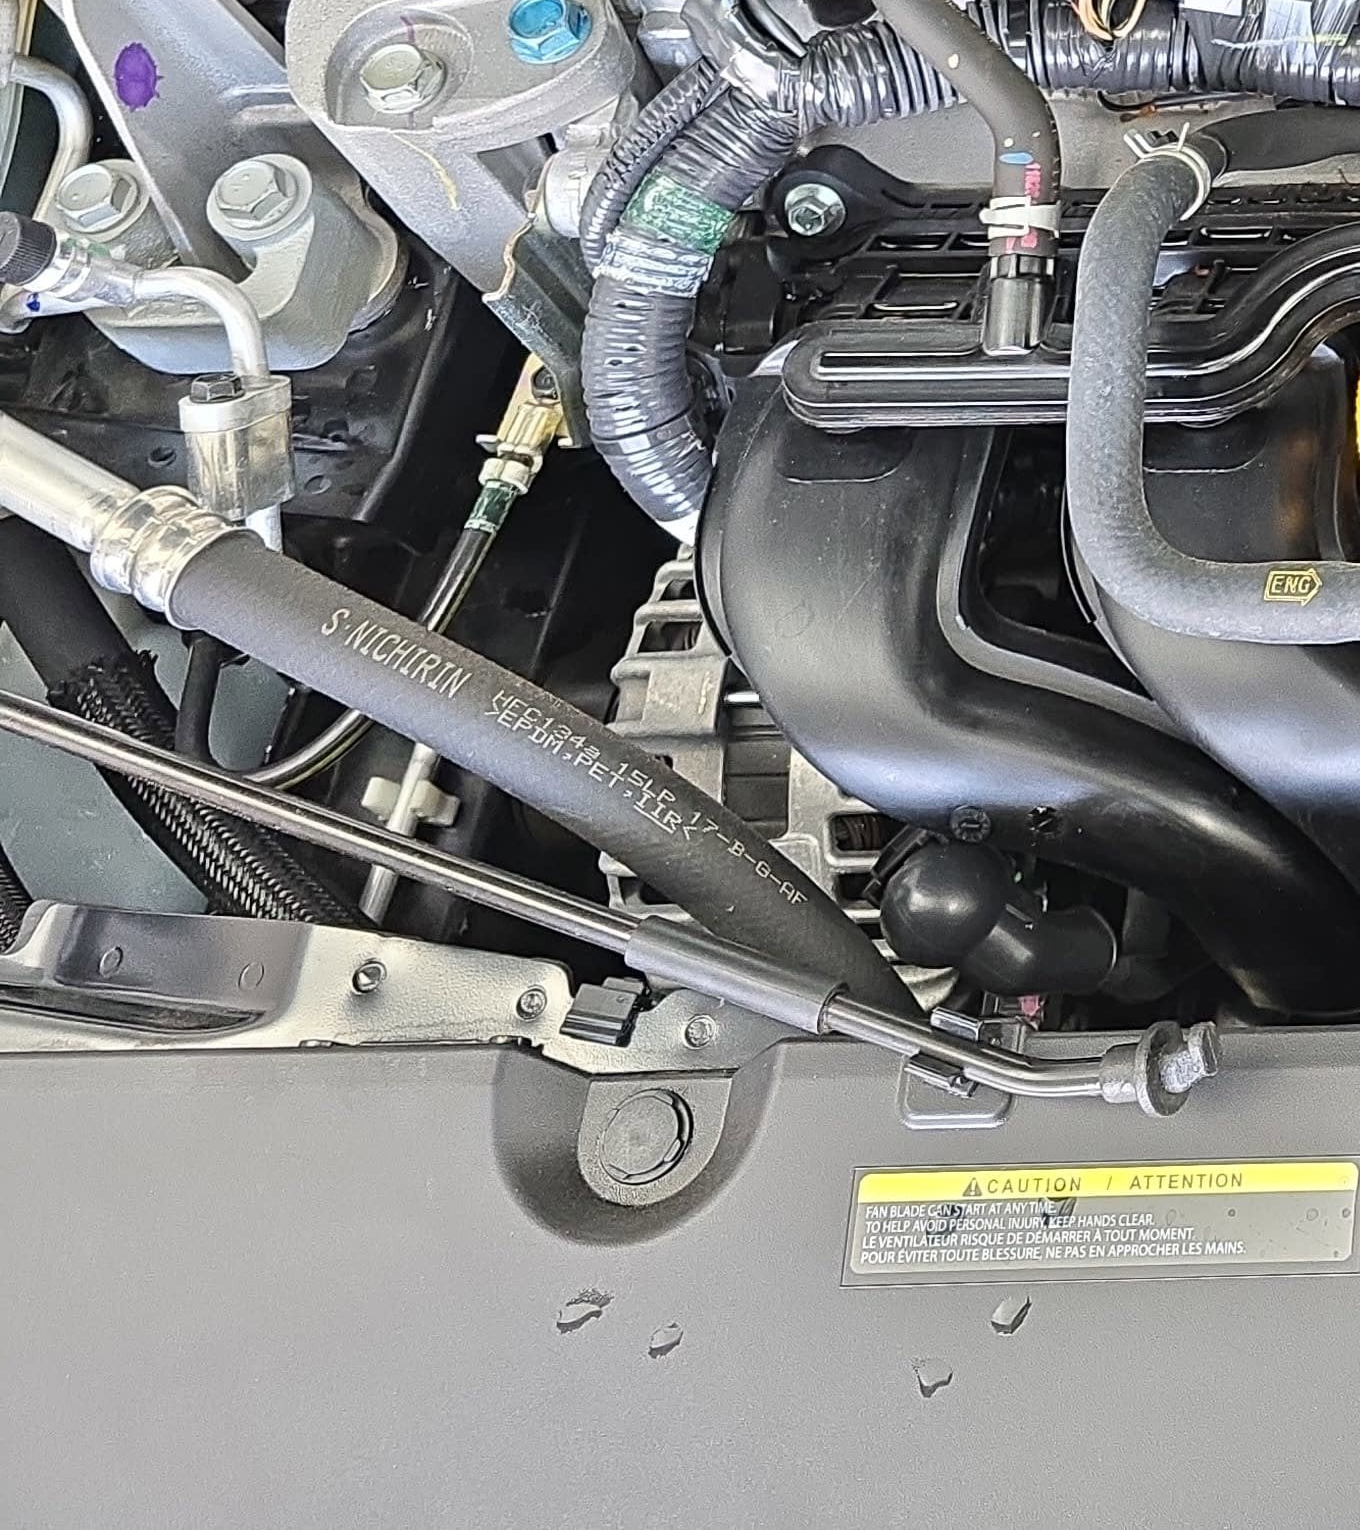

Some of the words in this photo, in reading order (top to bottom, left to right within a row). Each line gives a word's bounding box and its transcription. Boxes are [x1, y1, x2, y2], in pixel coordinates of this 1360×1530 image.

[1270, 575, 1312, 594] ENG
[615, 761, 677, 804] 15LP
[689, 811, 808, 905] 17-B-G-AF
[987, 1177, 1081, 1194] CAUTION
[1106, 1175, 1113, 1191] /
[1129, 1173, 1243, 1190] ATTENTION
[865, 1205, 888, 1218] FAN
[890, 1204, 926, 1218] BLADE
[928, 1204, 951, 1217] CAN
[953, 1203, 986, 1216] START
[989, 1202, 1003, 1215] AT
[1004, 1202, 1026, 1215] ANY
[1028, 1201, 1057, 1214] TIME.
[866, 1221, 881, 1233] TO
[883, 1220, 910, 1233] HELP
[912, 1219, 947, 1232] AVOID
[950, 1218, 1006, 1231] PERSONAL
[1008, 1216, 1047, 1231] INJURY,
[1049, 1216, 1076, 1229] KEEP
[1078, 1214, 1116, 1227] HANDS
[1118, 1213, 1155, 1227] CLEAR.
[863, 1236, 877, 1249] LE
[878, 1234, 958, 1248] VENTILATEUR
[960, 1233, 1005, 1247] RISQUE
[1007, 1232, 1021, 1245] DE
[1023, 1230, 1091, 1244] DÉMARRER
[1093, 1228, 1103, 1242] À
[1104, 1229, 1137, 1242] TOUT
[1138, 1227, 1195, 1240] MOMENT.
[860, 1250, 895, 1264] POUR
[898, 1247, 938, 1263] ÉVITER
[940, 1249, 979, 1262] TOUTE
[981, 1247, 1042, 1261] BLESSURE,
[1046, 1246, 1062, 1259] NE
[1064, 1246, 1087, 1258] PAS
[1089, 1245, 1105, 1257] EN
[1107, 1243, 1180, 1257] APPROCHER
[1182, 1243, 1202, 1256] LES
[1205, 1241, 1247, 1255] MAINS.
